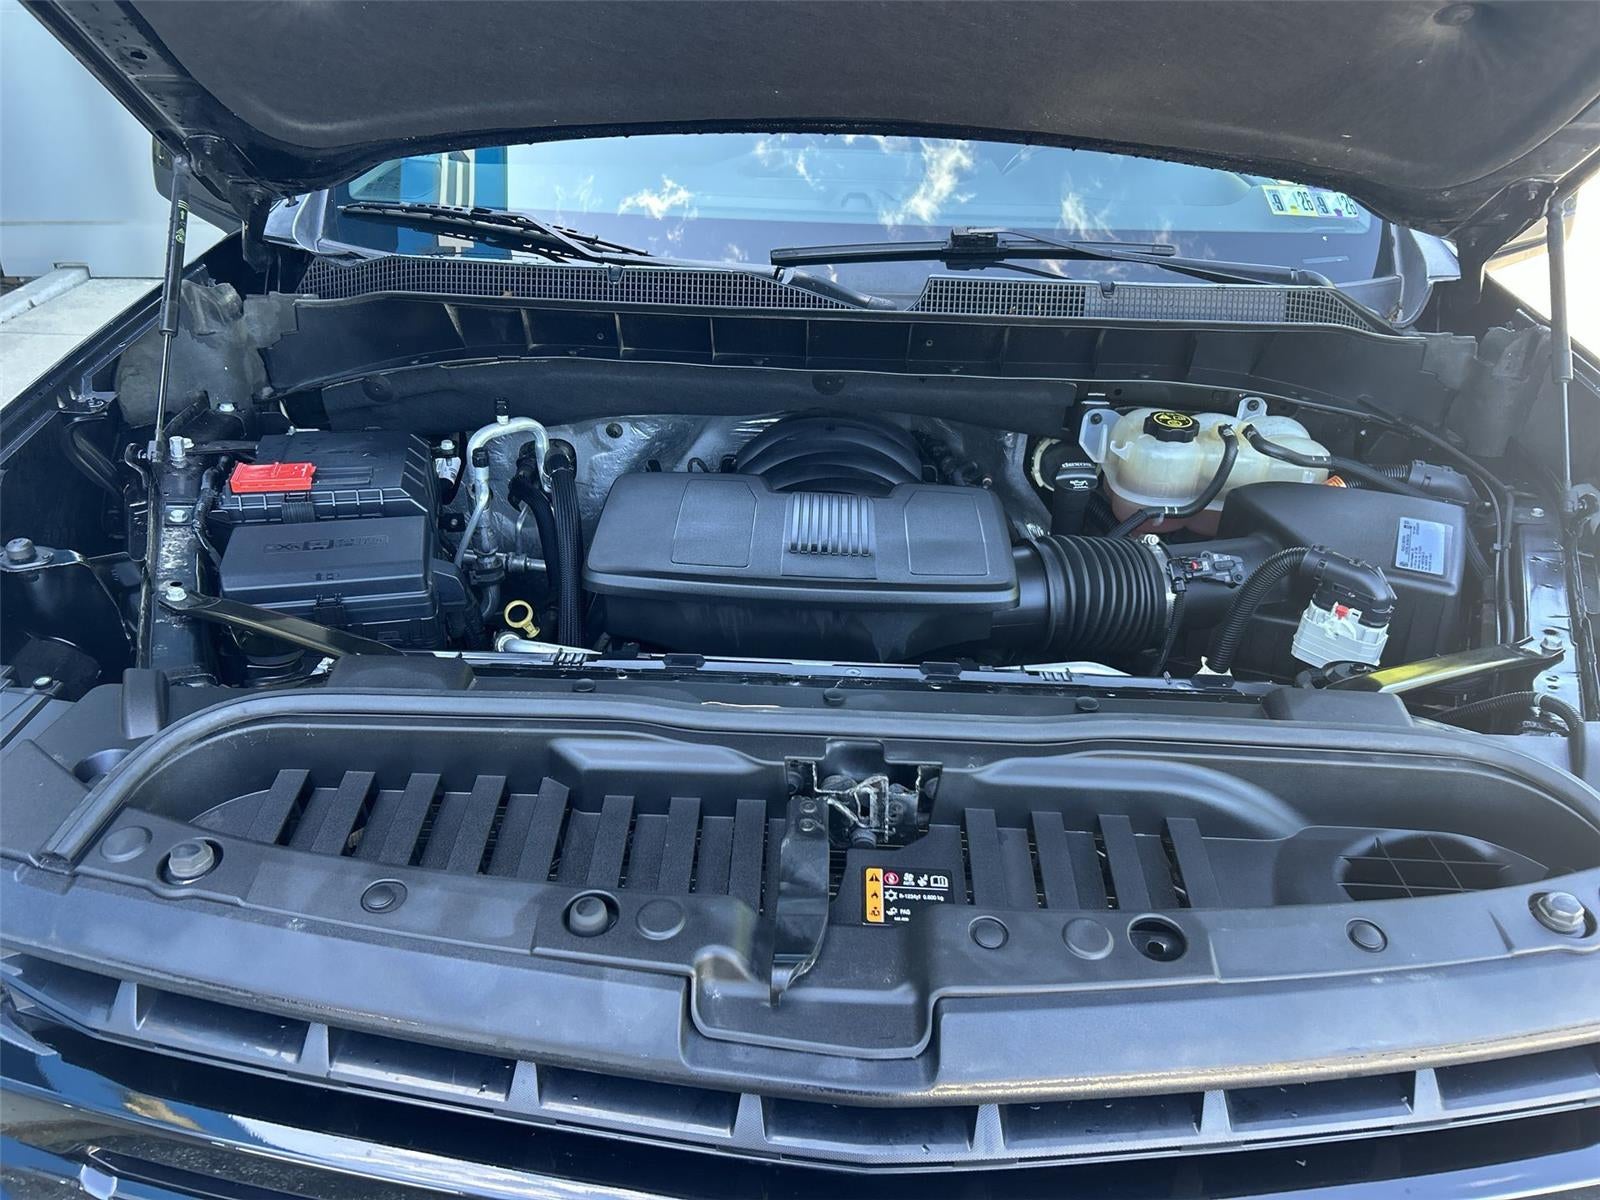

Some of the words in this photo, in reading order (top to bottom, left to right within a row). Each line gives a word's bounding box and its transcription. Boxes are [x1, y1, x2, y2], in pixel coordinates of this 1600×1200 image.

[1272, 193, 1284, 211] 9
[1297, 191, 1314, 211] 26
[1317, 196, 1329, 214] 9
